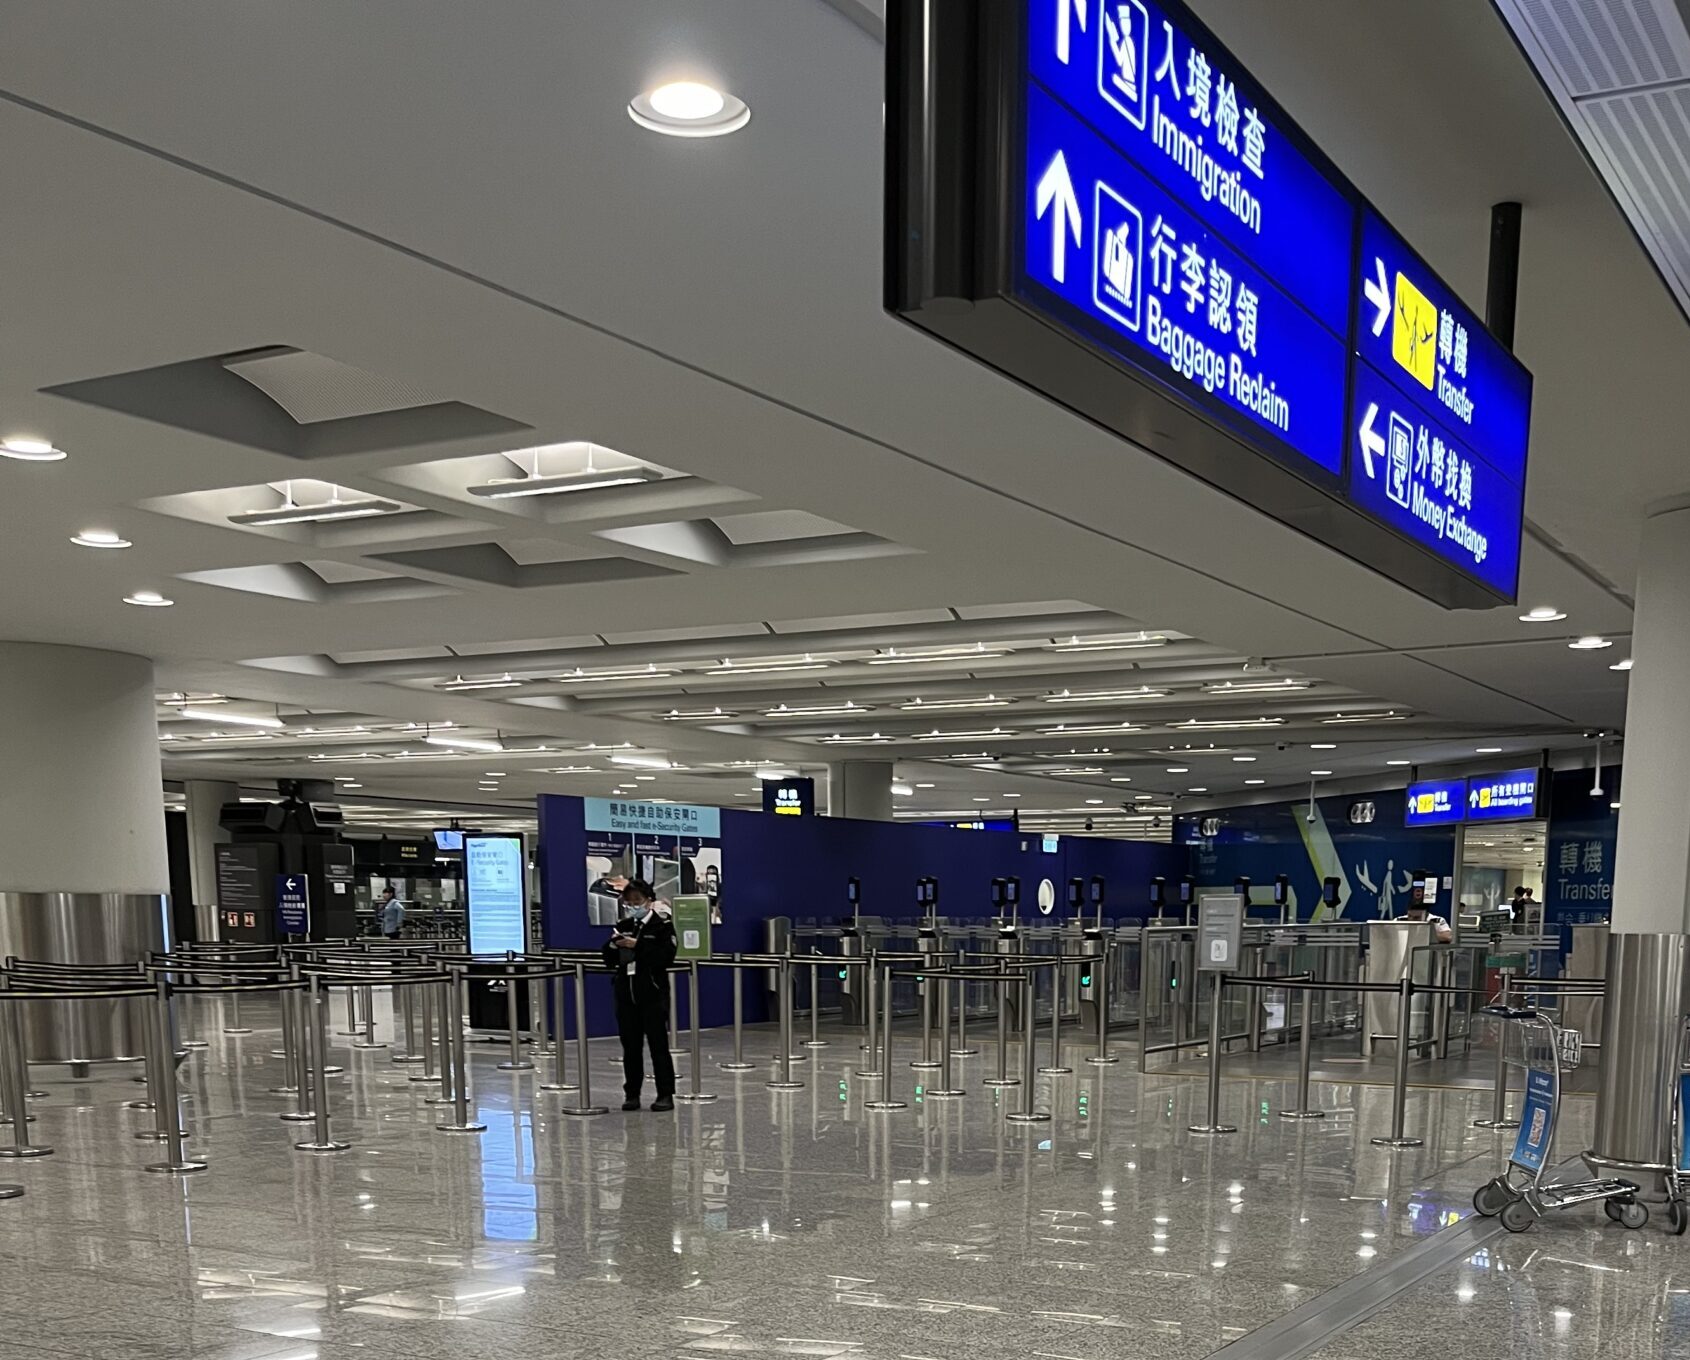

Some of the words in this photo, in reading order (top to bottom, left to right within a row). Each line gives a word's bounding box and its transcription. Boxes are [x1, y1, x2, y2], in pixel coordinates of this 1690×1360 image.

[1154, 20, 1265, 180] 入境檢查
[1152, 94, 1261, 235] Immigration
[1150, 214, 1259, 357] 行李認領
[1147, 294, 1226, 393] Baggage
[1229, 353, 1289, 432] Reclaim
[1439, 309, 1468, 379] 轉機
[1437, 363, 1474, 425] Transfer
[1415, 425, 1472, 511] 外幣找換
[1412, 481, 1446, 539] Money
[1446, 505, 1487, 563] Exchange
[607, 833, 613, 842] 1
[611, 818, 627, 830] Easy
[627, 821, 640, 829] and
[640, 820, 651, 830] fast
[652, 822, 680, 833] e-Security
[681, 823, 698, 832] Gates
[654, 835, 659, 845] 2
[698, 838, 703, 847] 3
[1559, 841, 1603, 874] 轉機
[1558, 877, 1611, 900] Transfe
